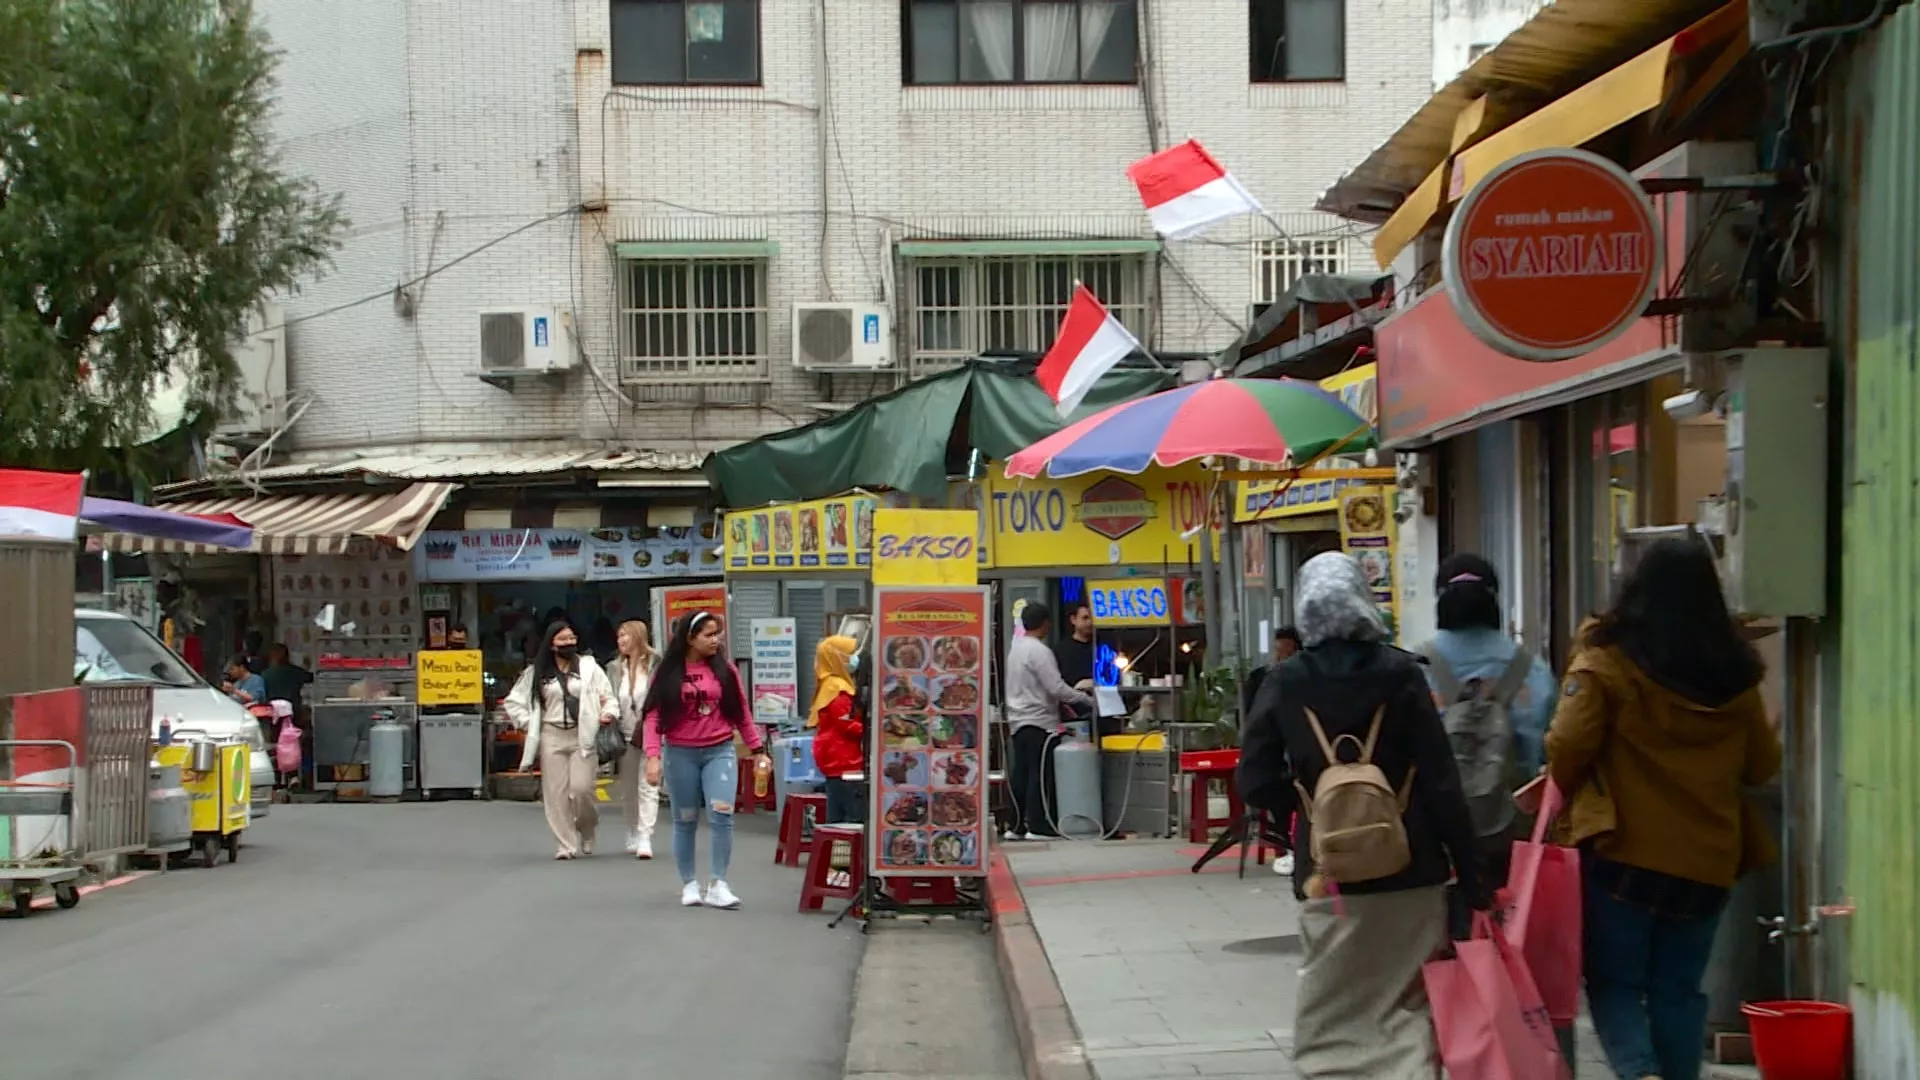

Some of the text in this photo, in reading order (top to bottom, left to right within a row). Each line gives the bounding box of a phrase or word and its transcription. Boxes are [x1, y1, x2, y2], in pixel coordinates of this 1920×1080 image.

[1495, 207, 1613, 226] rumah makan
[1469, 232, 1643, 280] SYARIAH
[993, 488, 1064, 533] TOKO
[878, 534, 973, 560] BAKSO
[1091, 586, 1167, 618] BAKSO
